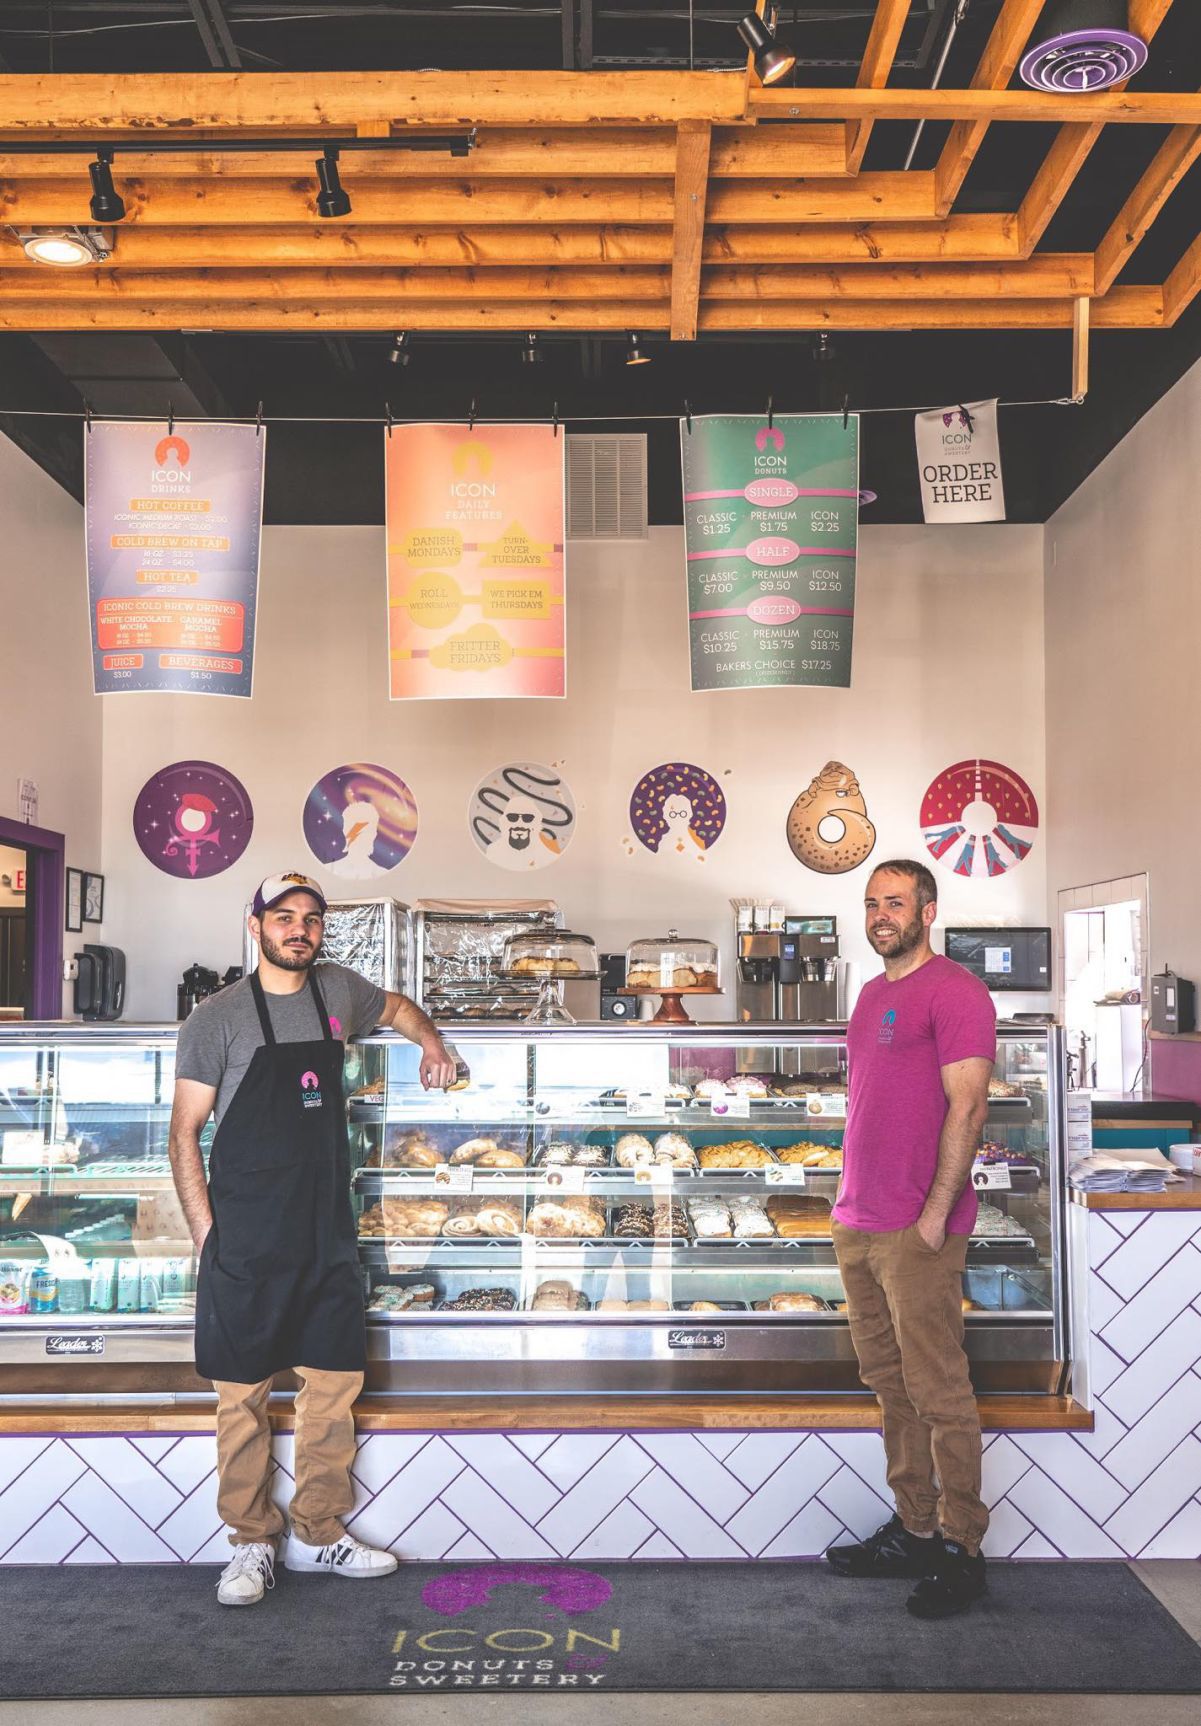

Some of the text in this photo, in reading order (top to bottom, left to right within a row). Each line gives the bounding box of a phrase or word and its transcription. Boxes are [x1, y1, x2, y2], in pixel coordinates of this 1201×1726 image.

[942, 433, 972, 445] ICON
[754, 456, 787, 467] ICON
[152, 470, 191, 482] ICON
[923, 462, 998, 482] ORDER
[152, 484, 191, 494] DRINKS
[451, 483, 496, 497] ICON
[750, 487, 794, 498] SINGLE
[932, 483, 991, 503] HERE
[137, 501, 204, 511] HOT COFFEE
[458, 500, 490, 510] DAILY
[445, 511, 502, 520] FEATURES
[696, 510, 839, 524] CLASSIC PREMIUM ICON
[703, 522, 840, 535] $1.25 $1.75 $2.25
[117, 537, 222, 549] COLD BREW ON TAP
[412, 536, 455, 547] DANISH
[407, 547, 461, 558] MONDAYS
[503, 545, 529, 554] OVER
[757, 546, 790, 557] HALF
[491, 555, 541, 564] TUESDAYS
[143, 572, 191, 583] HOT TEA
[698, 569, 840, 584] CLASSIC PREMIUM ICON
[420, 589, 448, 598] ROLL
[703, 581, 842, 595] $7.00 $9.50 $12.50
[490, 590, 543, 599] WE PICK EM
[103, 602, 236, 616] ICONIC COLD BREW DRINKS
[490, 600, 544, 609] THURSDAYS
[753, 605, 796, 616] DOZEN
[100, 615, 222, 626] WHITE CHOCOLATE CARAMEL
[119, 623, 217, 633] MOCHA MOCHA
[700, 629, 840, 643] CLASSIC PREMIUM ICON
[450, 640, 501, 651] FRITTER
[703, 640, 841, 655] $10.25 $15.75 $18.75
[111, 656, 234, 671] JUICE BEVERAGES
[450, 653, 502, 664] FRIDAYS
[716, 659, 832, 672] BAKERS CHOICE $17.25
[113, 670, 212, 680] $3.00 $1.50
[302, 1091, 322, 1101] ICON
[47, 1336, 91, 1350] Leader
[391, 1627, 621, 1654] ICON
[395, 1659, 553, 1672] DONUTS
[389, 1674, 606, 1686] SWEETERY
